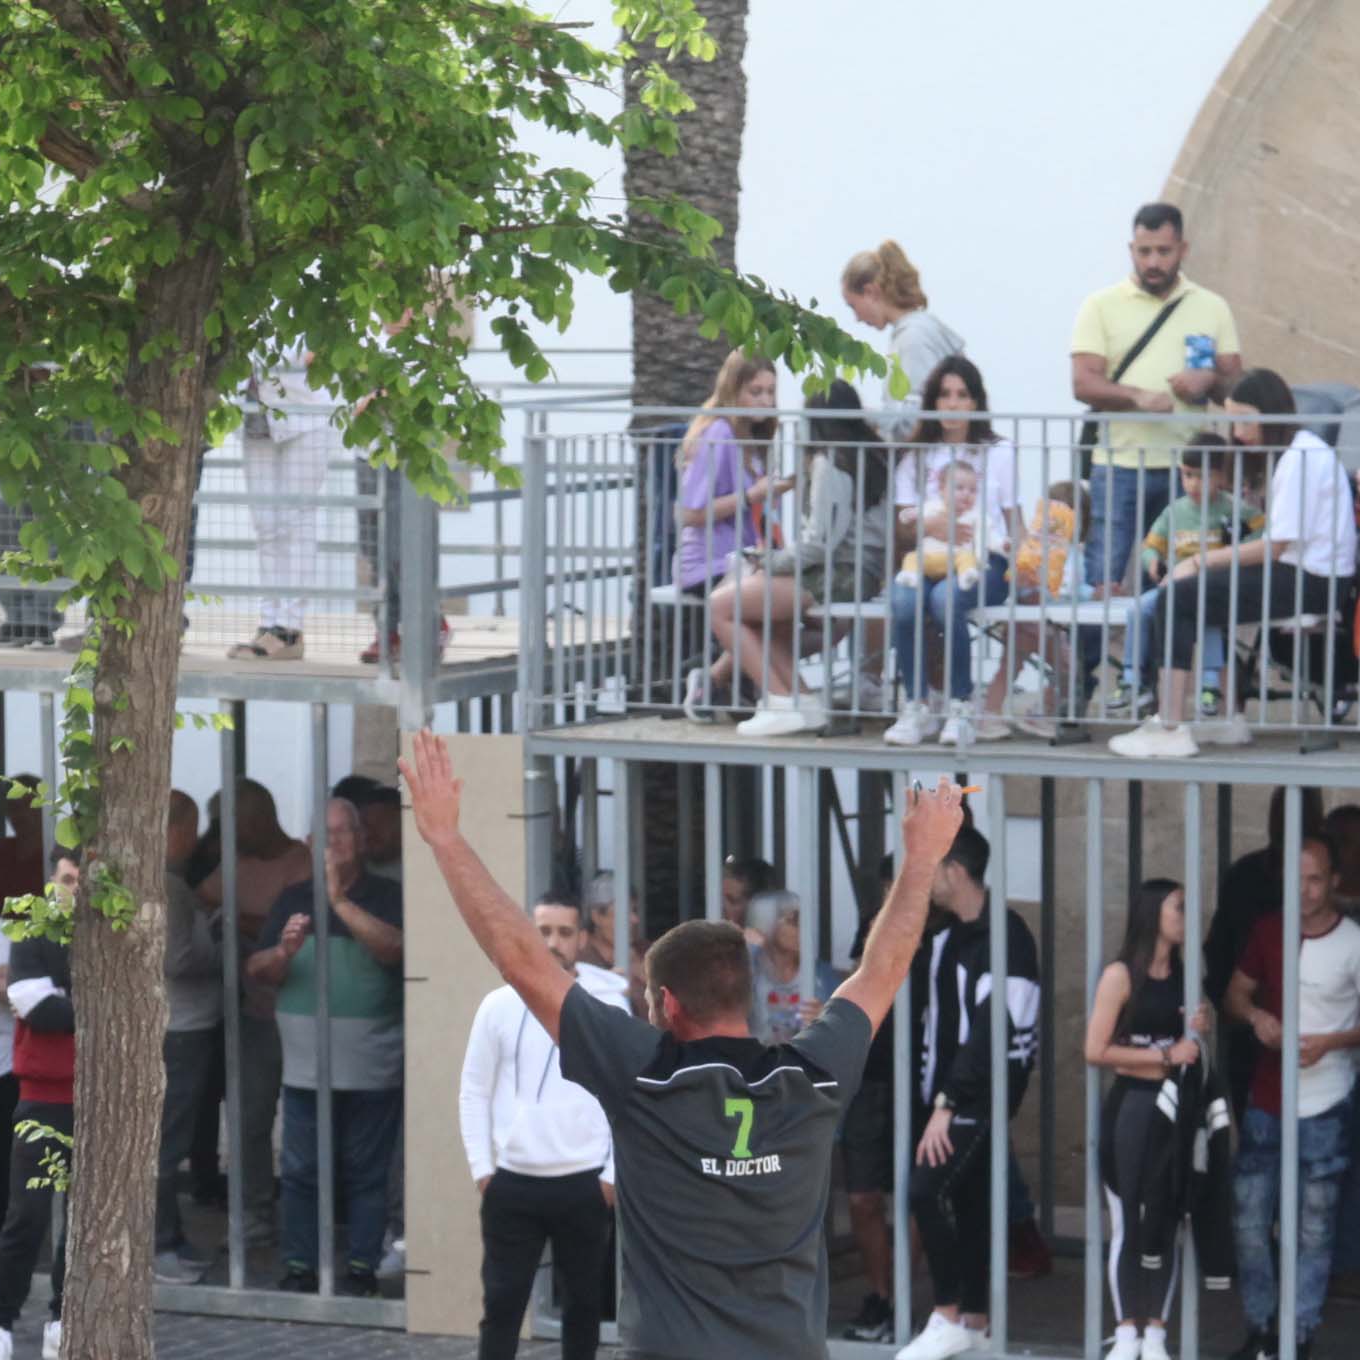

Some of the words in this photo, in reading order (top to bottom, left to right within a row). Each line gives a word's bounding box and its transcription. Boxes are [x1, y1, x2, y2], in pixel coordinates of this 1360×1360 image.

[724, 1097, 754, 1158] 7
[701, 1158, 722, 1176] EL
[725, 1154, 782, 1176] DOCTOR
